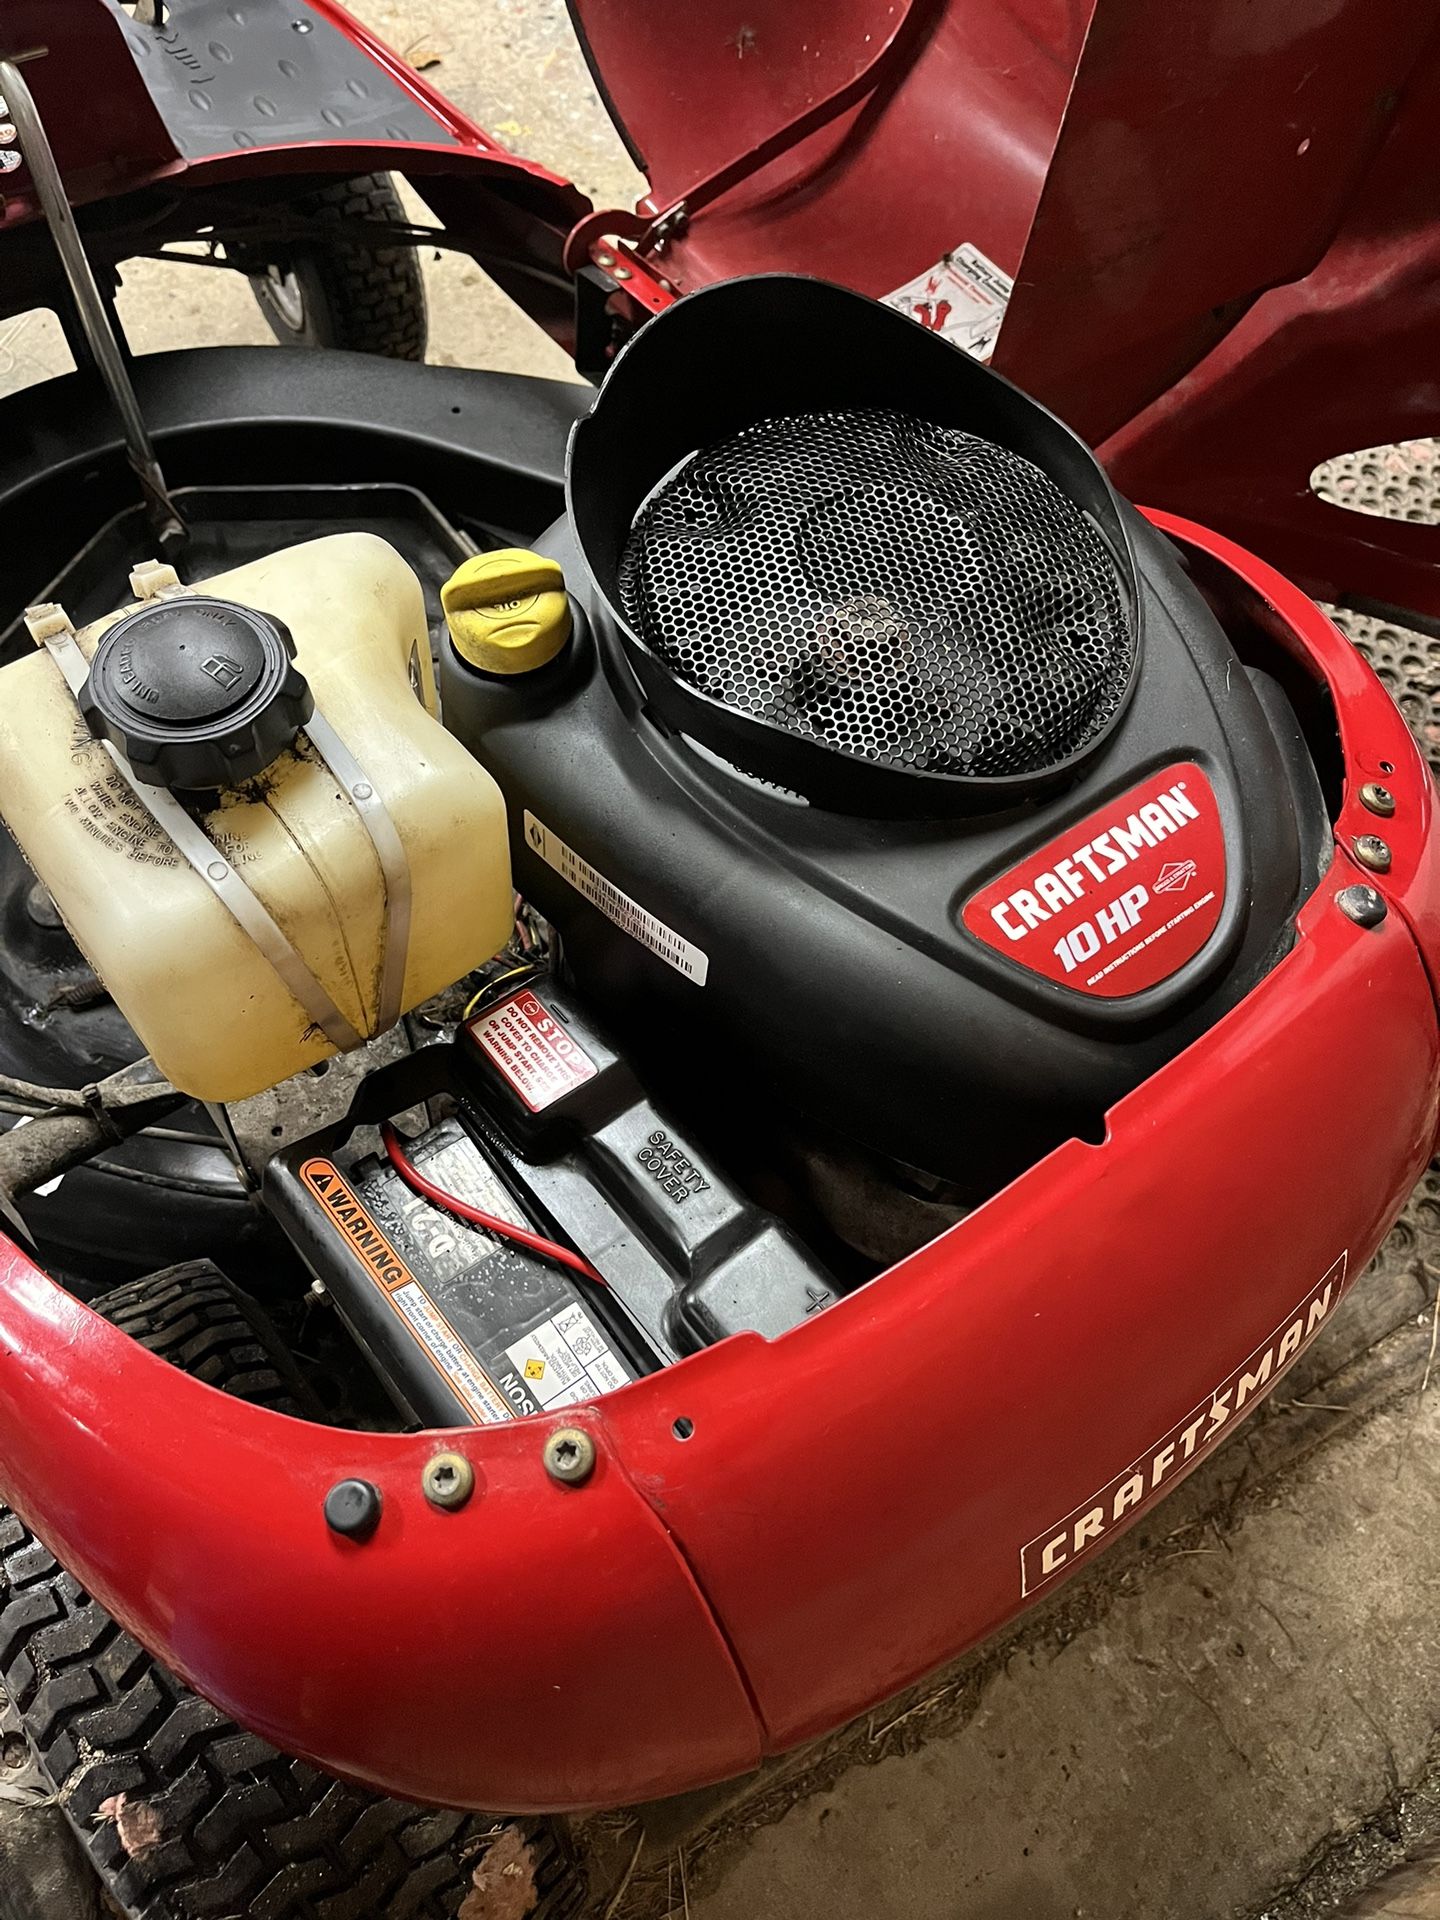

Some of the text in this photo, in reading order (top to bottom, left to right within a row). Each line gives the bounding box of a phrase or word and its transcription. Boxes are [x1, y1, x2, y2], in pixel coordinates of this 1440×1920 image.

[990, 786, 1201, 941] CRAFTSMAN
[1053, 883, 1150, 973] 10 HP
[483, 1030, 512, 1064] WARNING
[488, 1019, 500, 1031] OR
[497, 1030, 516, 1051] JUMP
[501, 1016, 522, 1041] COVER
[520, 1040, 532, 1052] TO
[506, 1006, 518, 1017] DO
[515, 1017, 531, 1033] NOT
[529, 1033, 555, 1062] REMOVE
[536, 1018, 583, 1066] STOP
[638, 1147, 690, 1204] COVER
[649, 1131, 711, 1193] SAFETY
[326, 1187, 403, 1284] WARNING
[1042, 1281, 1333, 1574] CRAFTSMAN
